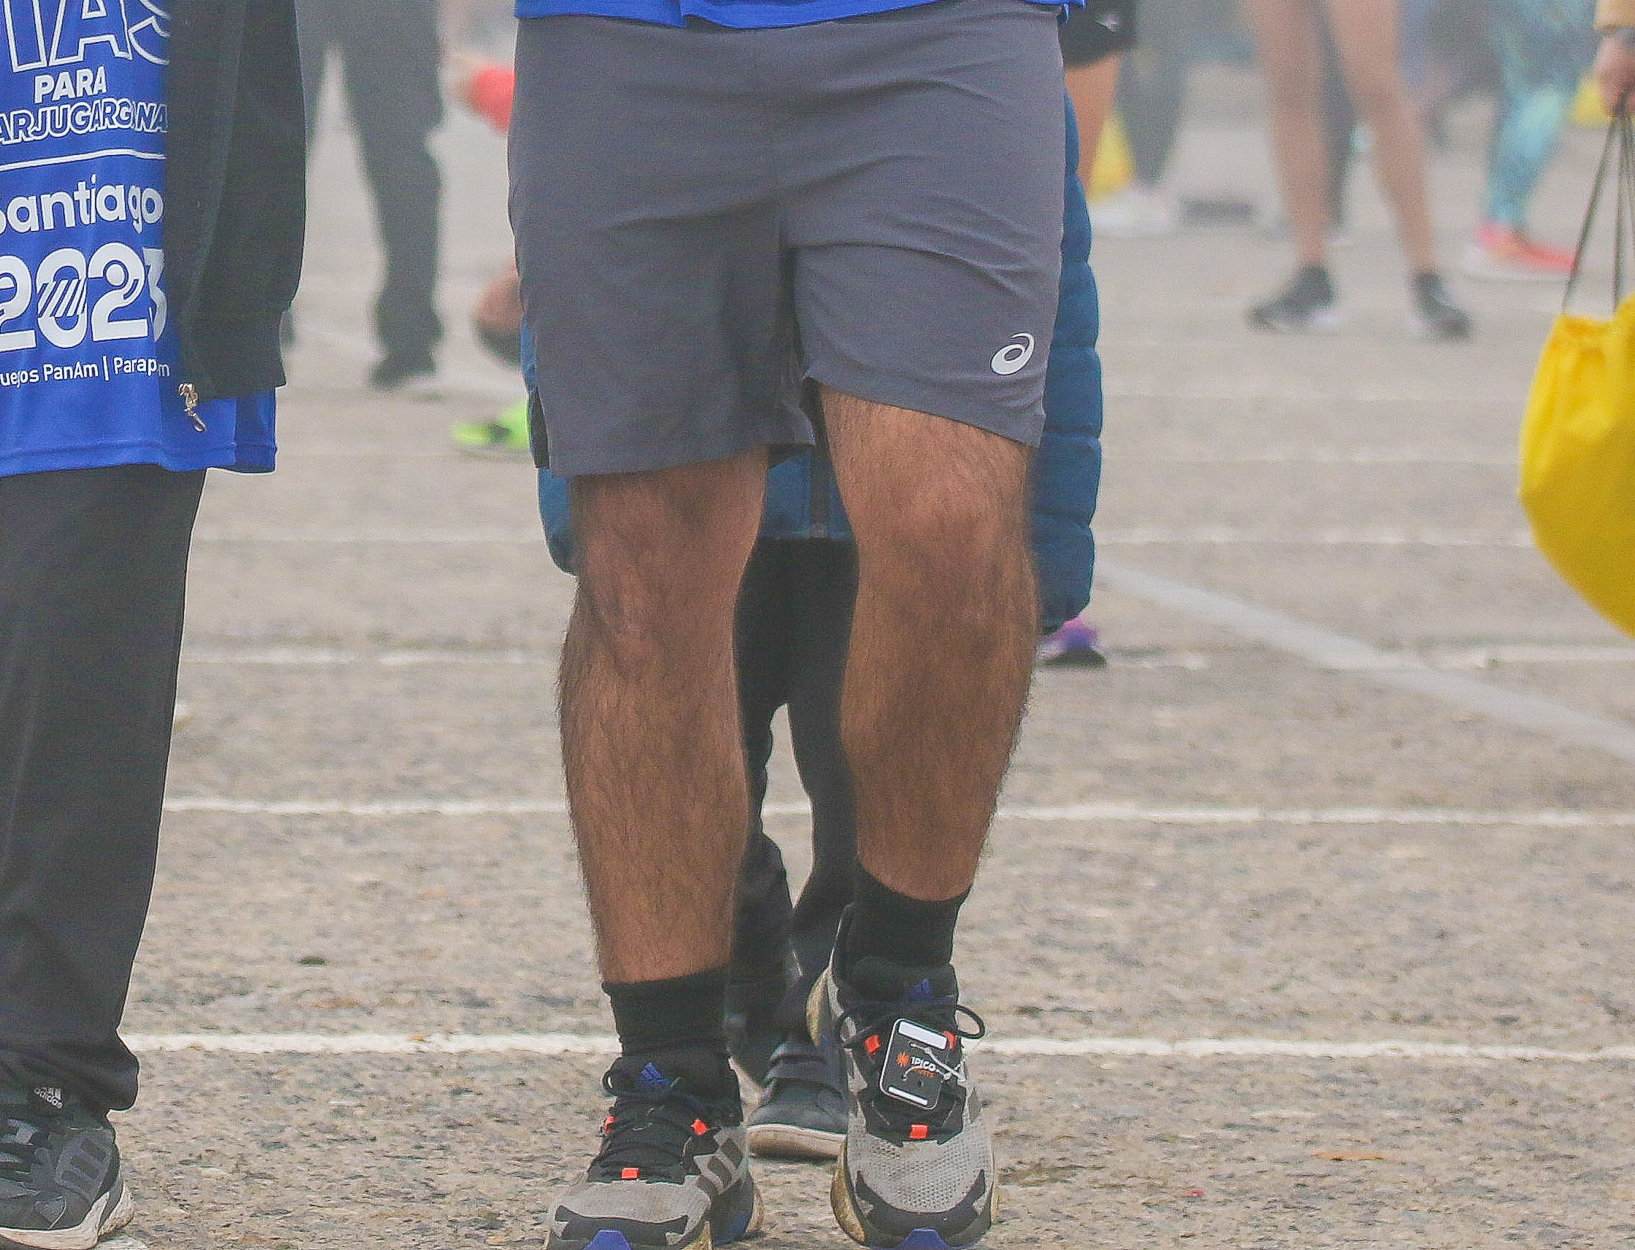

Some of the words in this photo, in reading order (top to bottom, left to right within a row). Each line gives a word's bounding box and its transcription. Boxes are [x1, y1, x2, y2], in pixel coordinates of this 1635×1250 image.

[34, 65, 107, 104] PARA
[43, 361, 99, 381] PanAm
[33, 1087, 63, 1109] adidas
